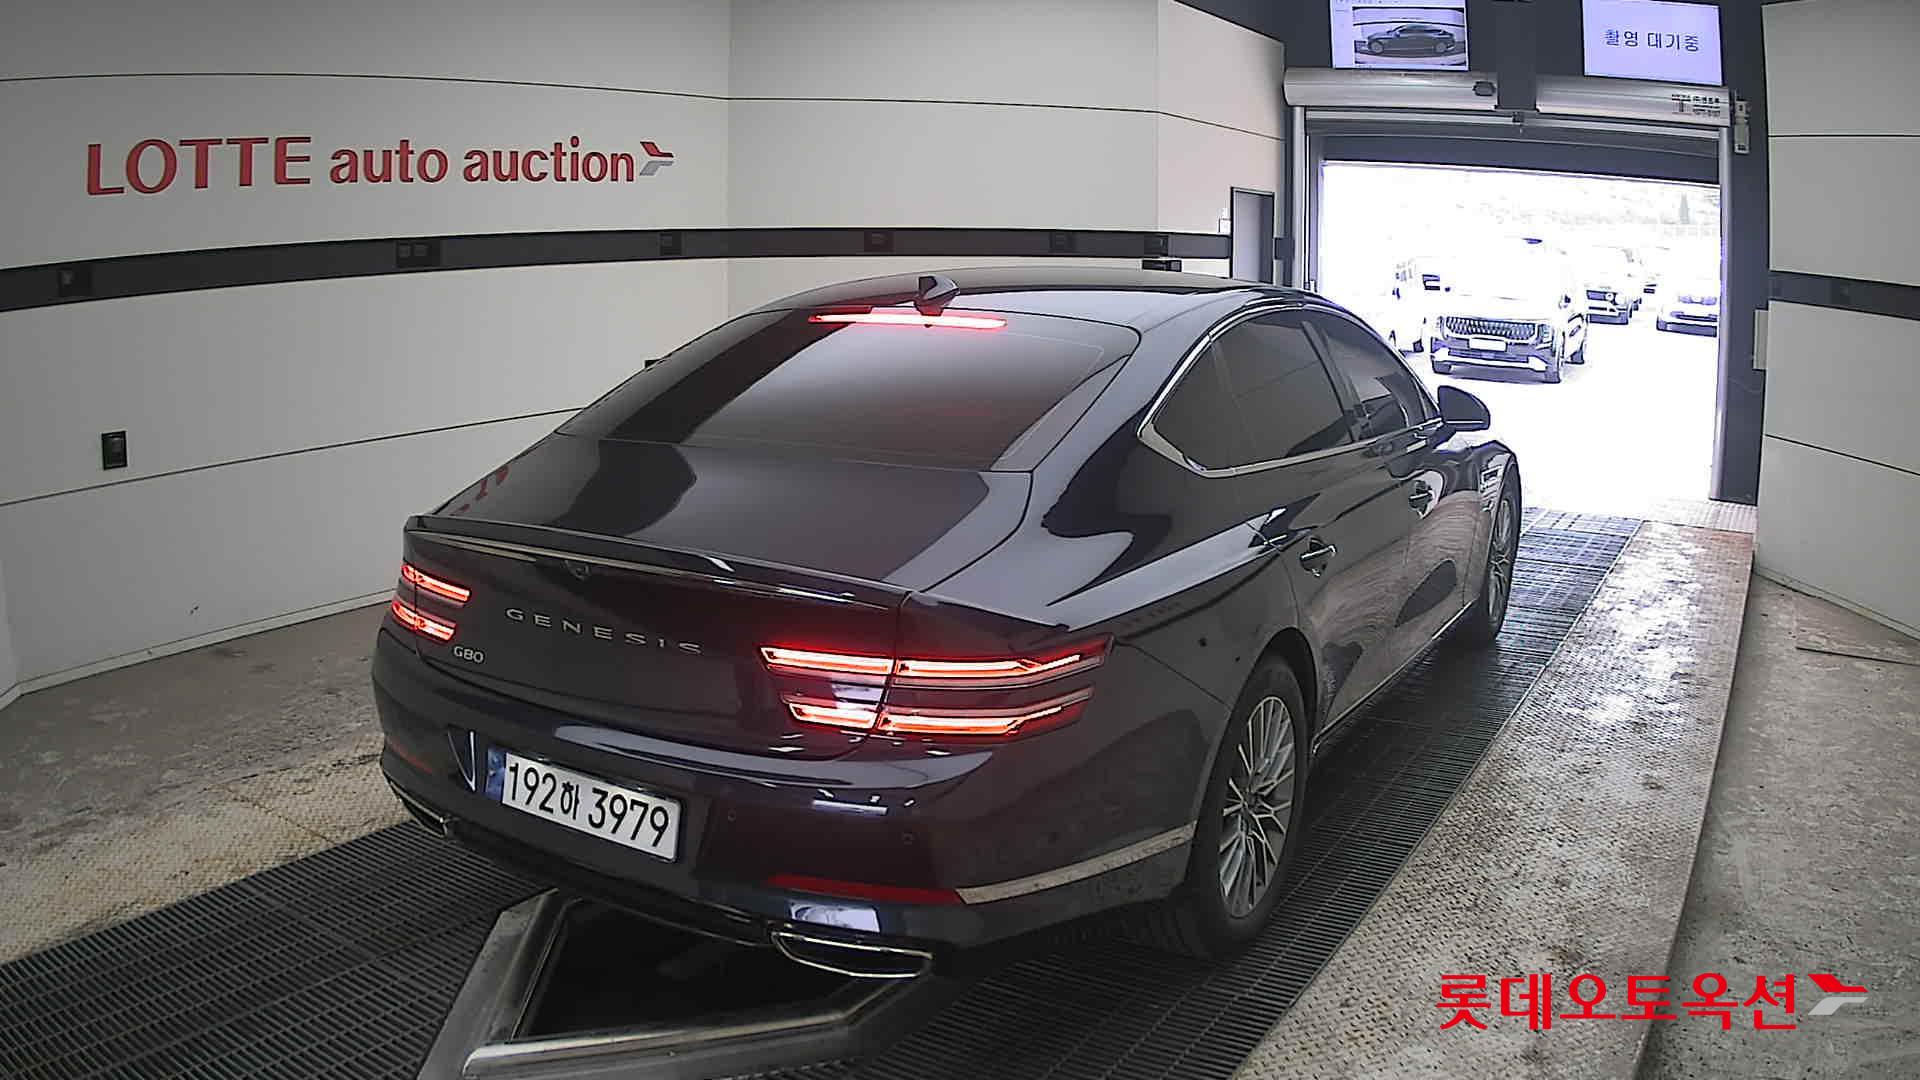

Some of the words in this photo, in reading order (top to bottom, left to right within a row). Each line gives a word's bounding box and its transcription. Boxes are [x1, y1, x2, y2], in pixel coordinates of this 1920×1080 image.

[1647, 32, 1698, 52] 대기중
[87, 136, 311, 195] LOTTE
[329, 139, 448, 184] auto
[463, 135, 634, 184] auction
[505, 608, 702, 654] GENESIS
[453, 645, 484, 664] G80
[508, 761, 580, 821] 192하
[587, 787, 670, 848] 3979
